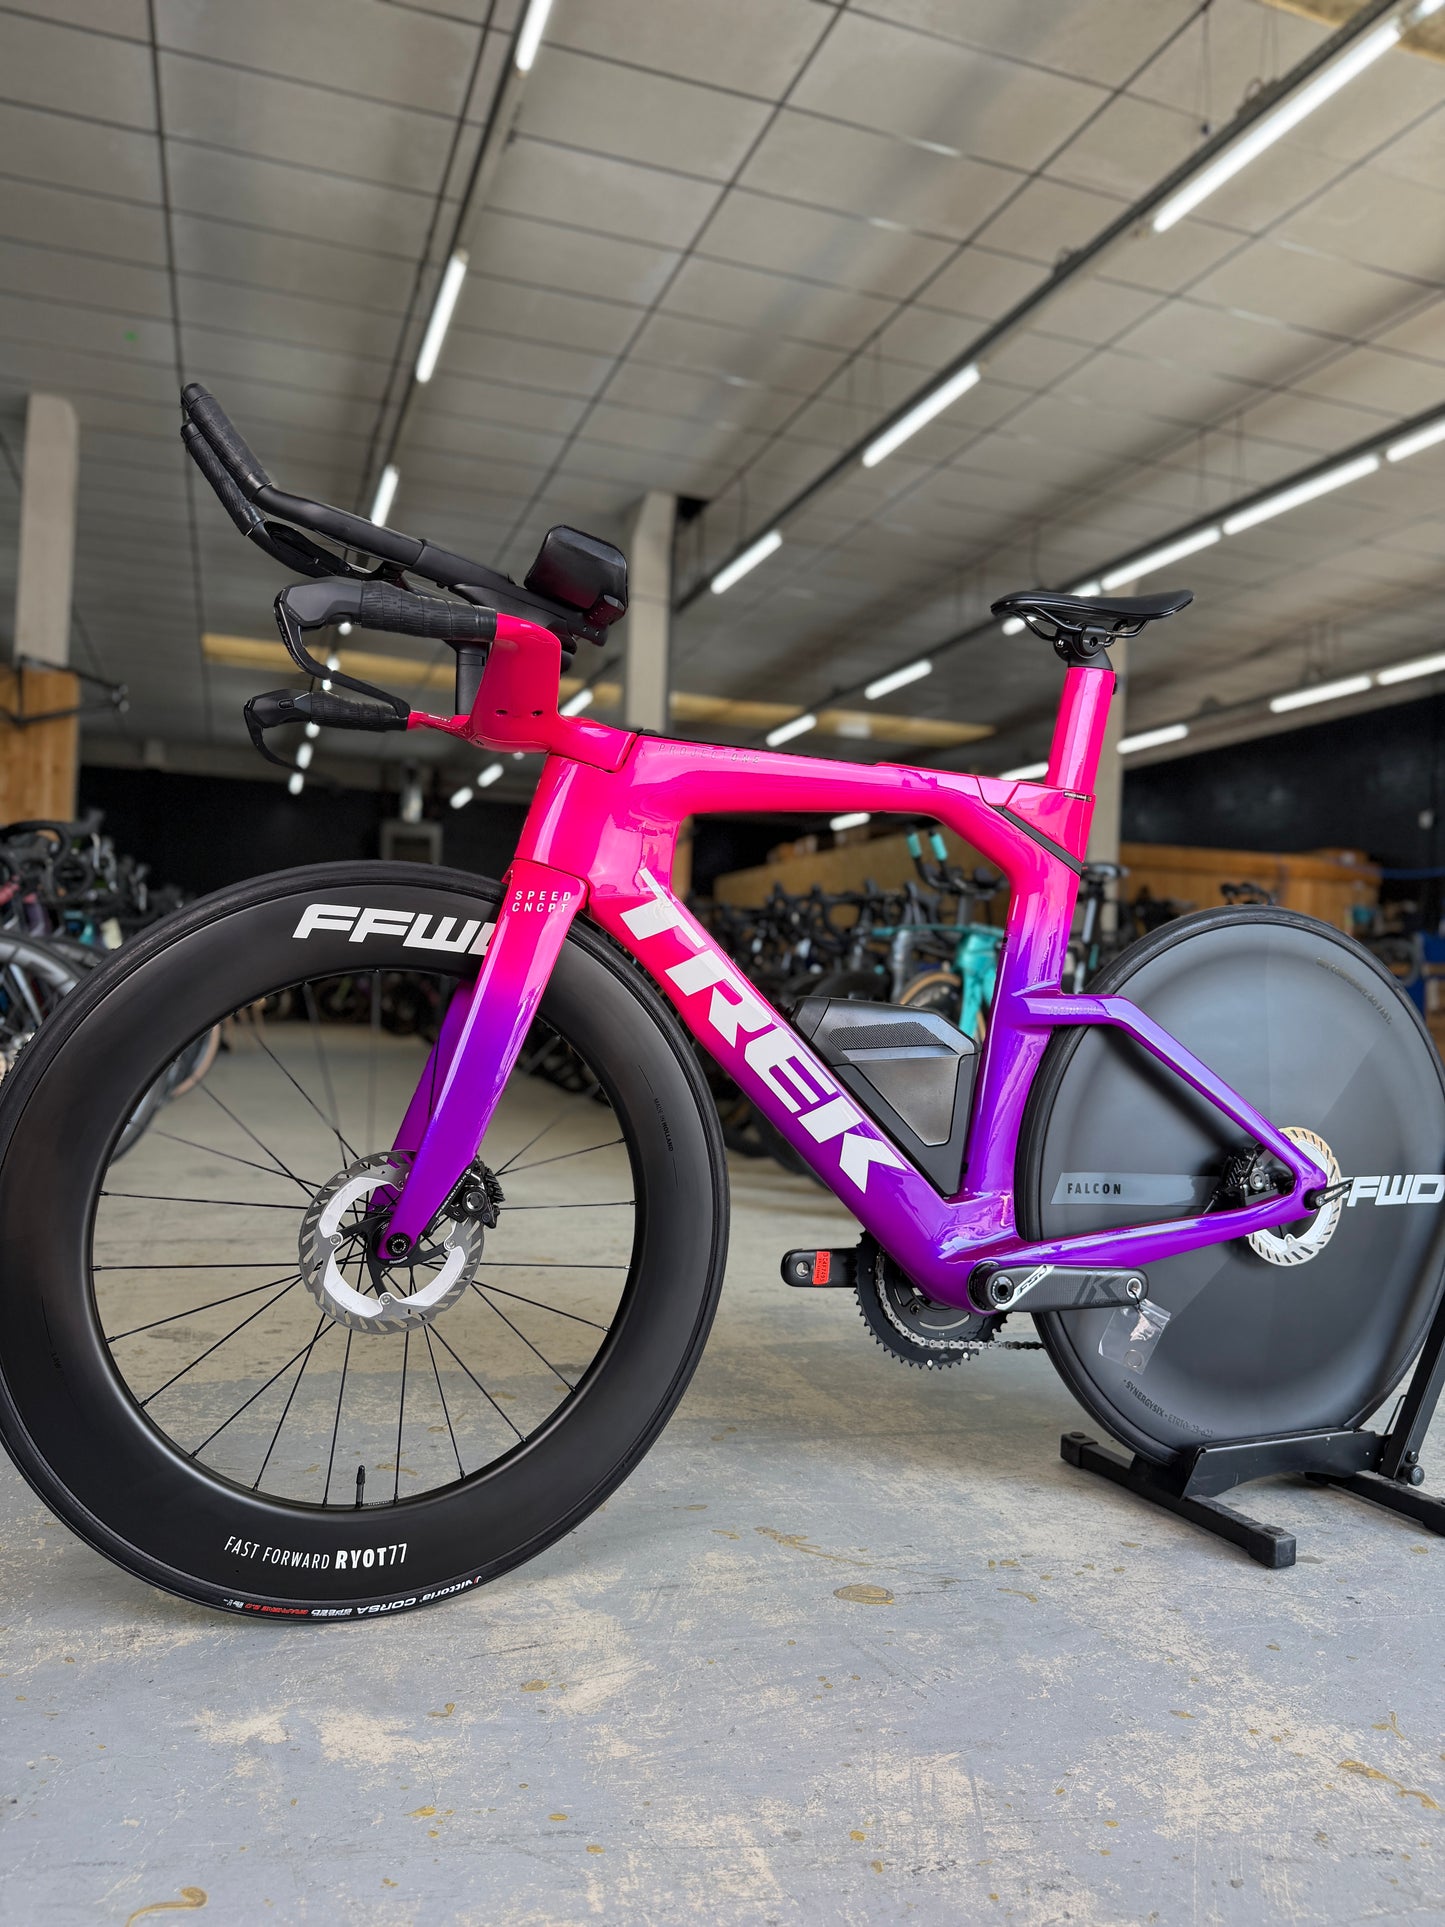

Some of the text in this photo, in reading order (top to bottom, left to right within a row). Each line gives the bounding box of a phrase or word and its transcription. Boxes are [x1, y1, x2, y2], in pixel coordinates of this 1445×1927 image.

[512, 902, 568, 912] CNCPT
[515, 890, 571, 901] SPEED
[620, 868, 907, 1194] TREK
[662, 1121, 674, 1152] HOLLAND
[1067, 1183, 1121, 1195] FALCON
[1125, 1381, 1165, 1417] SYNERGYSIX
[224, 1536, 408, 1570] FAST FORWARD RYOT77
[357, 1598, 417, 1615] CORSA
